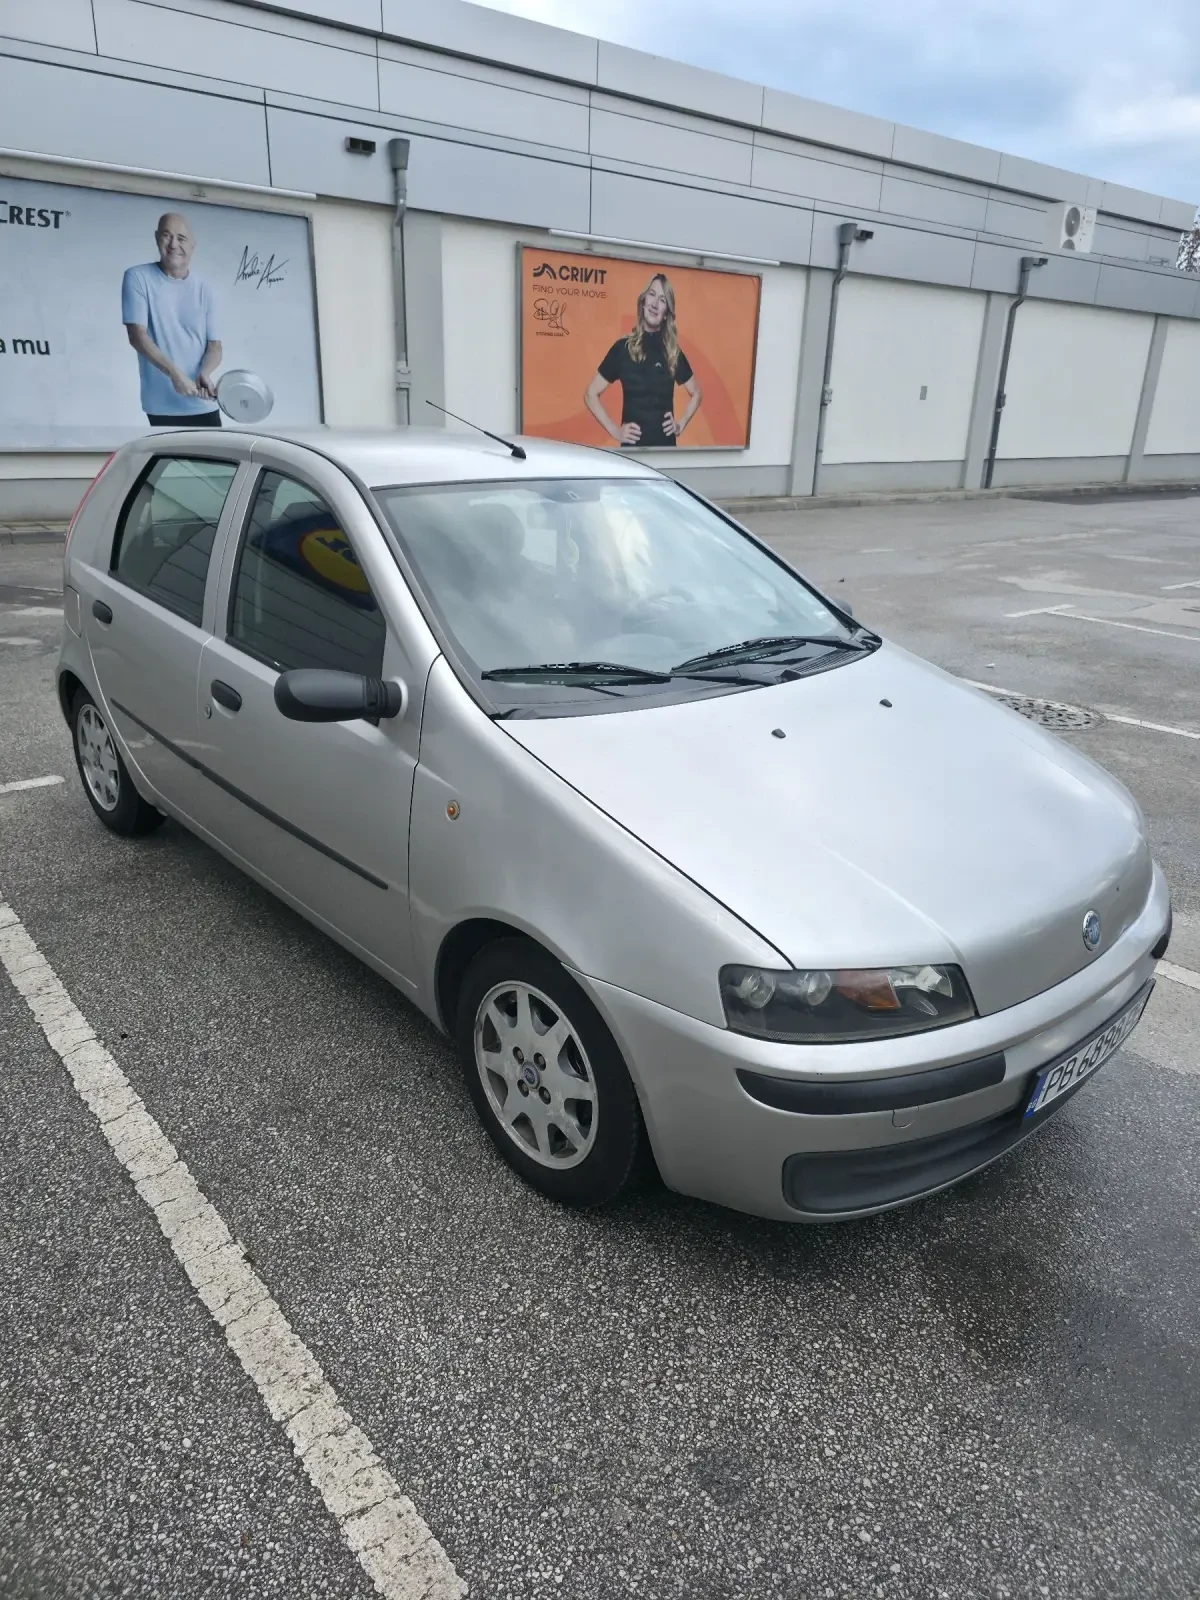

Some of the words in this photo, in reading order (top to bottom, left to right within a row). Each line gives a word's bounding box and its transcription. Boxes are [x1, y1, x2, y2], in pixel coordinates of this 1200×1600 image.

[558, 265, 607, 285] CRIVIT
[532, 284, 554, 294] FIND
[556, 287, 580, 297] YOUR
[581, 289, 607, 299] MOVE
